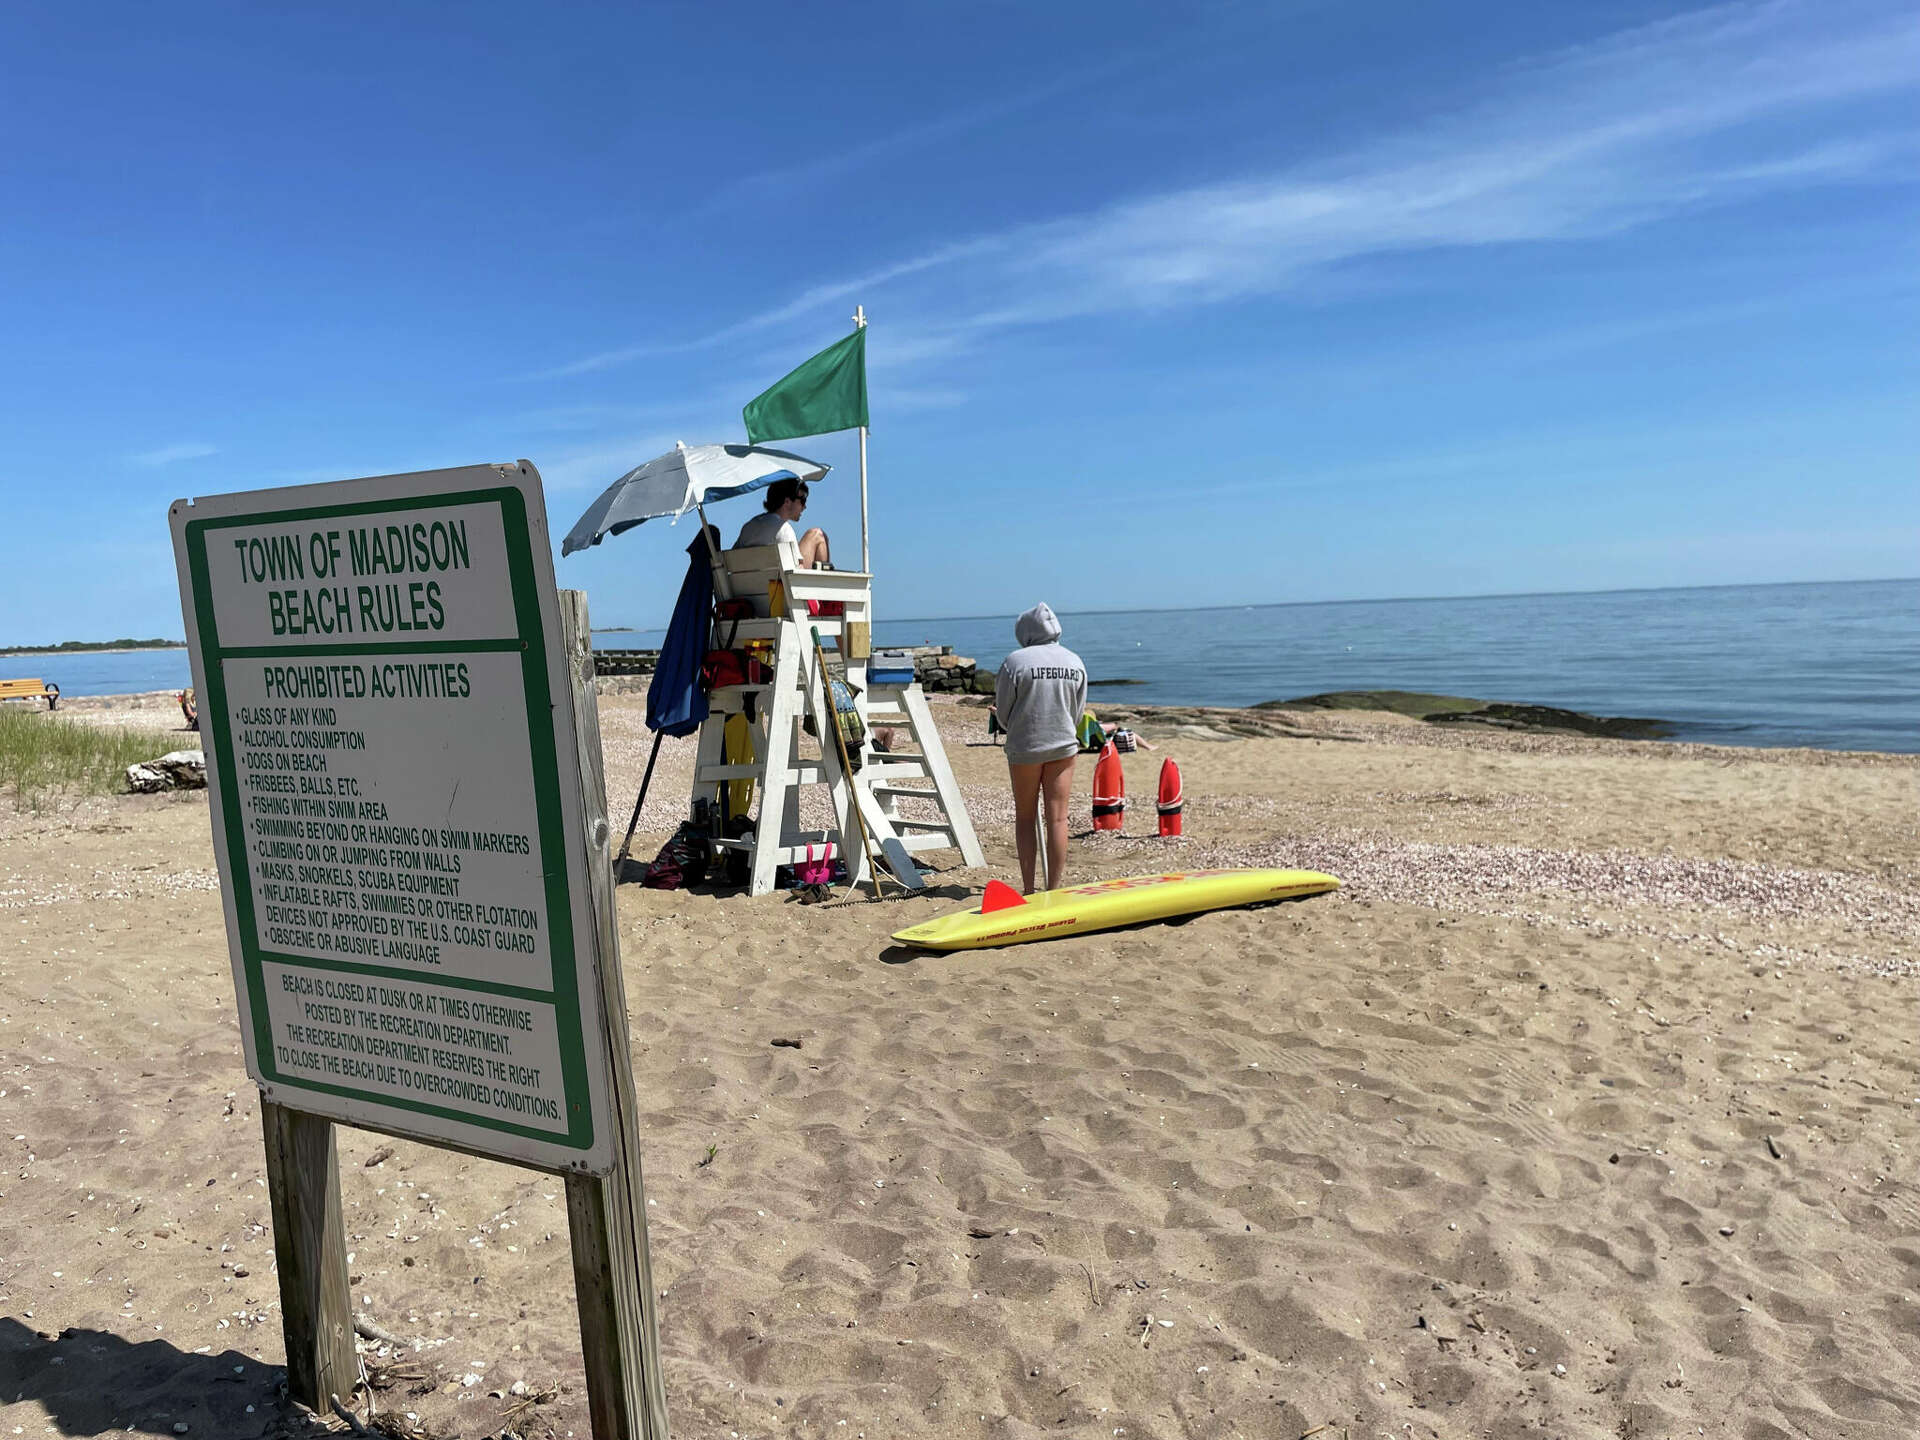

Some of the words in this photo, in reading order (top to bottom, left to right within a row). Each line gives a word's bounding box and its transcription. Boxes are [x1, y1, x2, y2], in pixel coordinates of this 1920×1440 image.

[235, 535, 304, 583] TOWN
[311, 532, 341, 579] OF
[349, 520, 470, 576] MADISON
[269, 588, 353, 635] BEACH
[358, 582, 444, 632] RULES
[264, 666, 366, 698] PROHIBITED
[372, 664, 470, 698] ACTIVITIES
[1031, 667, 1080, 681] LIFEGUARD
[242, 708, 272, 725] GLASS
[275, 708, 287, 725] OF
[291, 708, 309, 725] ANY
[312, 709, 336, 726] KIND
[245, 731, 289, 748] ALCOHOL
[291, 731, 365, 750] CONSUMPTION
[247, 753, 274, 770] DOGS
[276, 754, 290, 770] ON
[292, 754, 327, 772] BEACH
[250, 775, 298, 796] FRISBEES,
[301, 777, 336, 798] BALLS,
[338, 778, 362, 796] ETC.
[253, 797, 290, 815] FISHING
[291, 799, 326, 817] WITHIN
[329, 801, 356, 819] SWIM
[359, 803, 388, 821] AREA
[256, 819, 304, 838] SWIMMING
[307, 822, 348, 841] BEYOND
[352, 825, 367, 842] OR
[369, 826, 419, 846] HANGING
[423, 829, 438, 847] ON
[441, 830, 470, 850] SWIM
[473, 833, 529, 855] MARKERS
[259, 841, 303, 860] CLIMBING
[306, 844, 320, 861] ON
[323, 846, 338, 863] OR
[341, 847, 387, 867] JUMPING
[390, 850, 421, 869] FROM
[423, 853, 461, 873] WALLS
[262, 862, 297, 884] MASKS,
[299, 866, 356, 889] SNORKELS,
[359, 871, 396, 890] SCUBA
[398, 874, 459, 897] EQUIPMENT
[264, 884, 321, 906] INFLATABLE
[323, 890, 359, 913] RAFTS,
[362, 894, 415, 915] SWIMMIES
[418, 899, 434, 917] OR
[437, 901, 474, 922] OTHER
[477, 905, 538, 930] FLOTATION
[267, 906, 306, 926] DEVICES
[308, 911, 328, 928] NOT
[333, 913, 388, 934] APPROVED
[391, 919, 404, 936] BY
[407, 920, 428, 940] THE
[431, 924, 451, 943] U.S.
[455, 926, 491, 948] COAST
[495, 931, 535, 954] GUARD
[271, 928, 315, 948] OBSCENE
[318, 933, 333, 951] OR
[336, 936, 379, 956] ABUSIVE
[382, 941, 440, 964] LANGUAGE
[283, 975, 313, 995] BEACH
[315, 980, 324, 997] IS
[326, 981, 364, 1002] CLOSED
[367, 987, 377, 1004] AT
[381, 988, 408, 1009] DUSK
[410, 993, 424, 1012] OR
[427, 996, 437, 1014] AT
[440, 998, 469, 1020] TIMES
[473, 1003, 532, 1031] OTHERWISE
[305, 1003, 341, 1024] POSTED
[344, 1009, 355, 1026] BY
[359, 1011, 378, 1030] THE
[380, 1014, 441, 1041] RECREATION
[444, 1025, 512, 1055] DEPARTMENT.
[287, 1024, 304, 1043] THE
[306, 1028, 364, 1053] RECREATION
[367, 1038, 429, 1065] DEPARTMENT
[433, 1049, 484, 1076] RESERVES
[486, 1060, 507, 1082] THE
[509, 1065, 540, 1088] RIGHT
[278, 1046, 289, 1064] TO
[291, 1049, 320, 1070] CLOSE
[322, 1055, 340, 1074] THE
[343, 1059, 375, 1080] BEACH
[377, 1065, 397, 1084] DUE
[399, 1069, 411, 1087] TO
[414, 1072, 490, 1104] OVERCROWDED
[494, 1089, 561, 1120] CONDITIONS.
